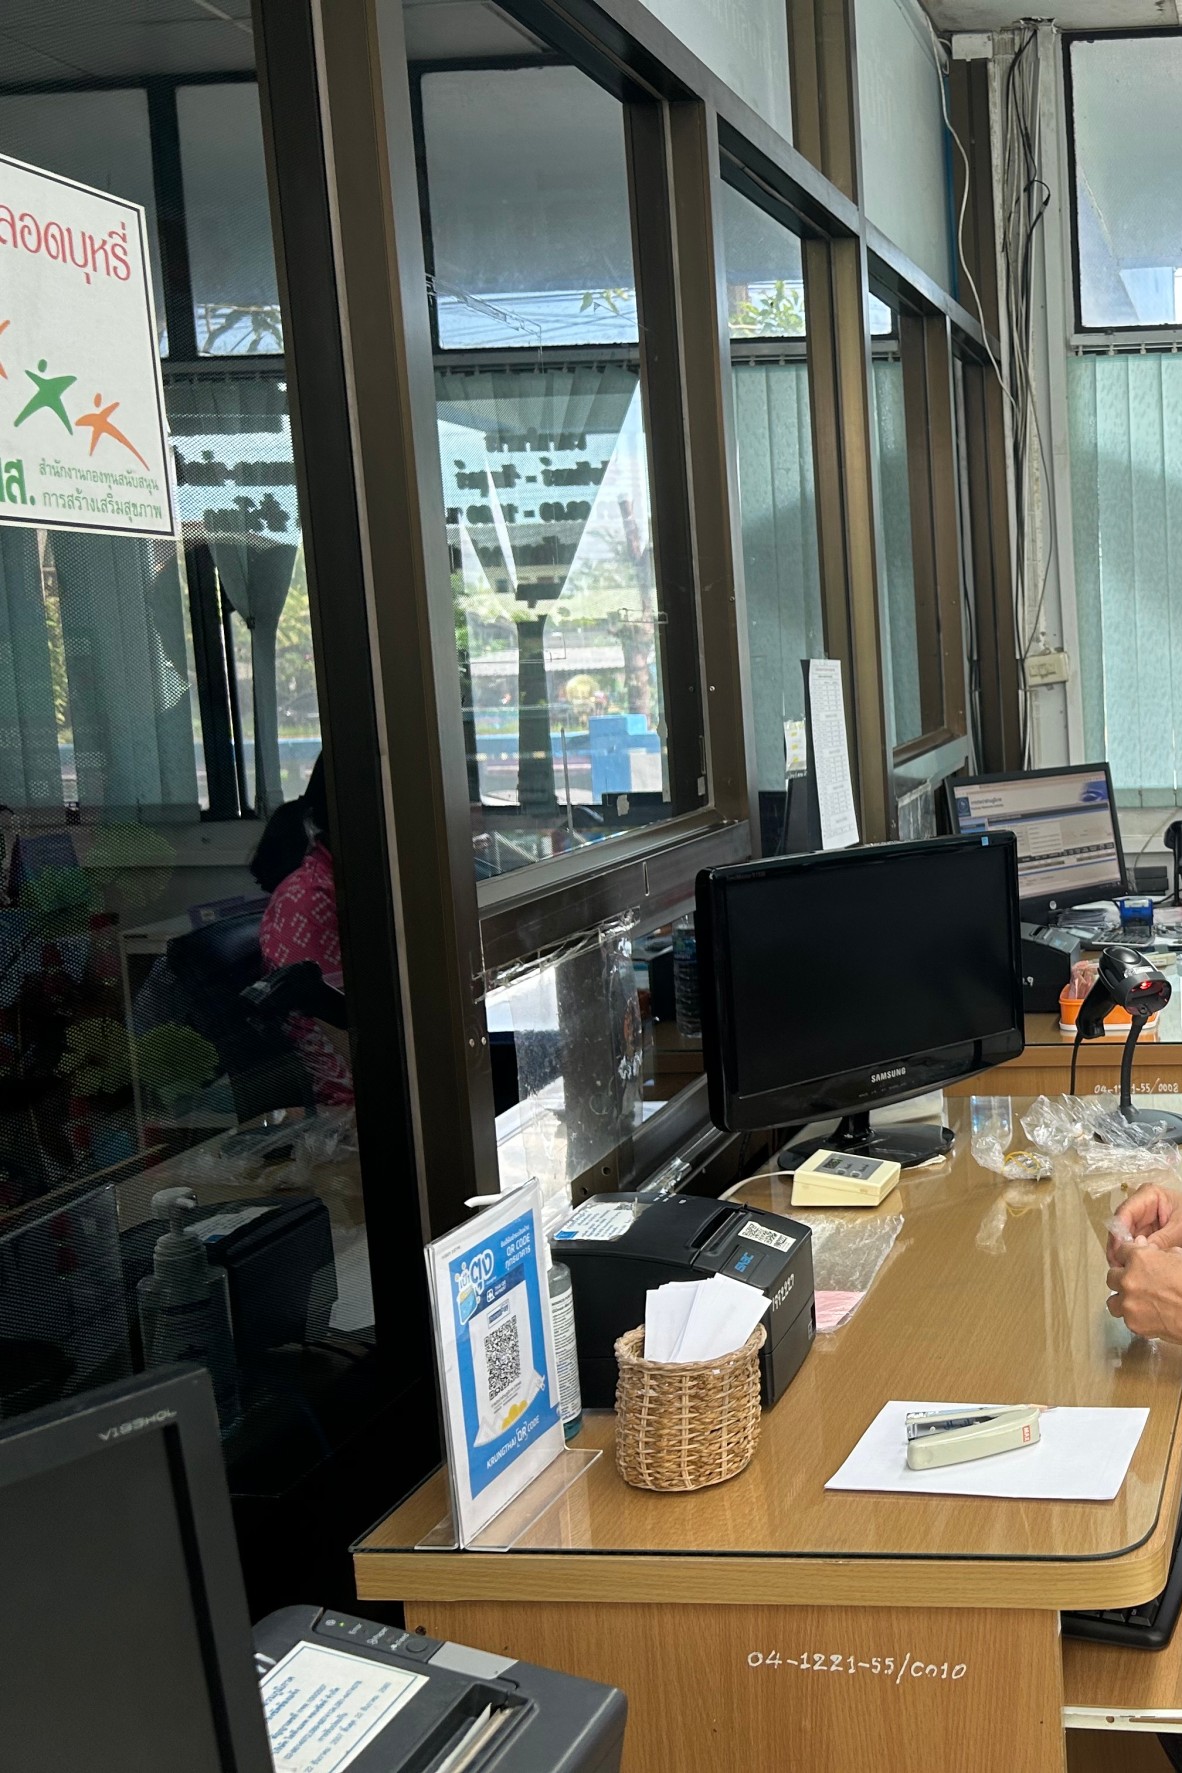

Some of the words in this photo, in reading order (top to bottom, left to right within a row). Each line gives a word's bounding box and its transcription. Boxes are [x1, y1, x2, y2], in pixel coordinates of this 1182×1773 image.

[39, 457, 160, 498] สำนักงานกองทุนสนับสนุน
[43, 486, 163, 523] การสร้างเสริมสุขภาพ
[871, 1066, 907, 1084] SAMSUNG
[515, 1232, 531, 1251] CODE
[486, 1437, 517, 1470] KRUNGTHAI
[516, 1425, 528, 1443] QR
[527, 1414, 540, 1432] CODE
